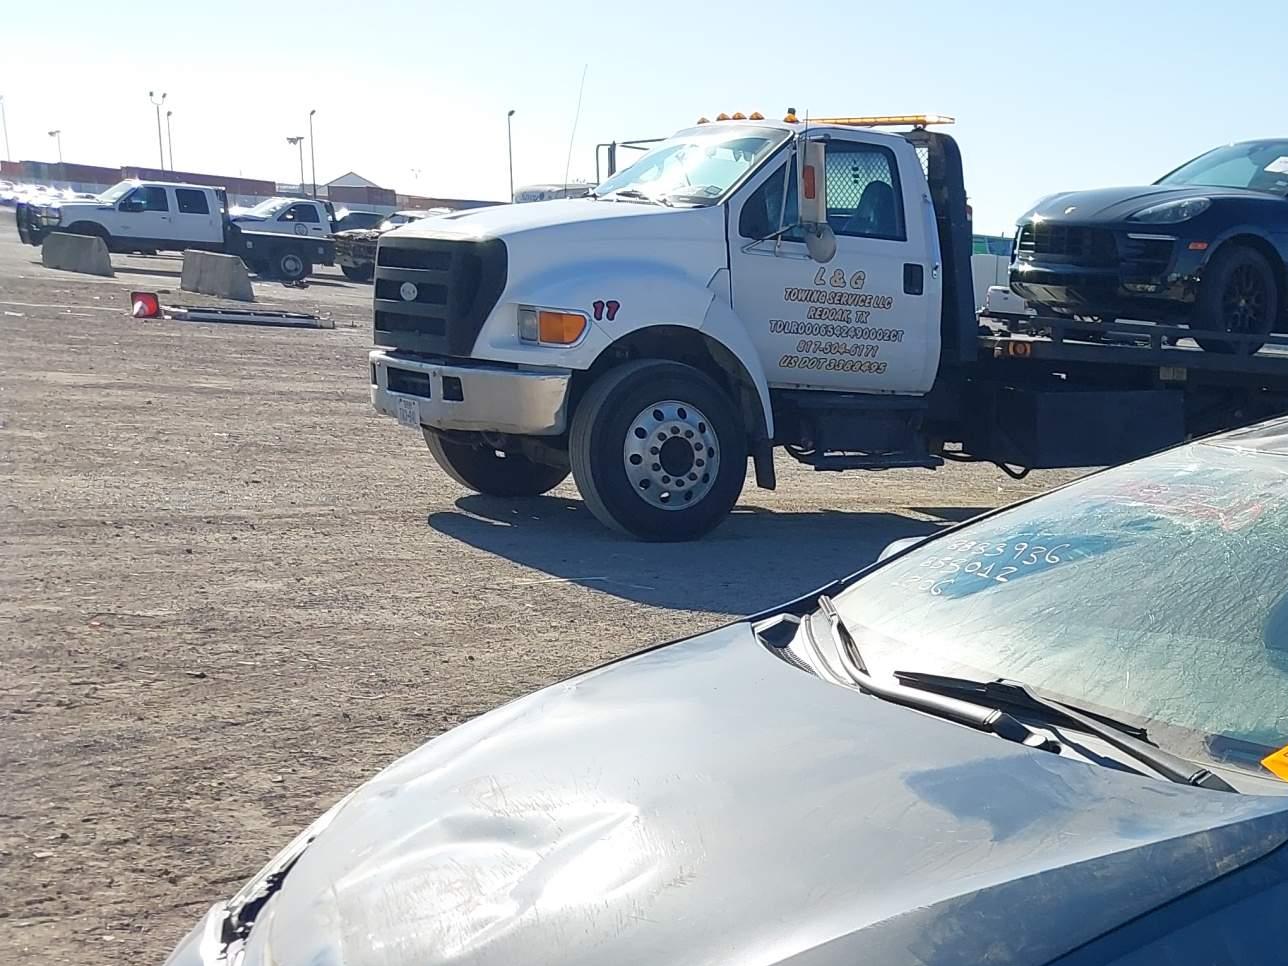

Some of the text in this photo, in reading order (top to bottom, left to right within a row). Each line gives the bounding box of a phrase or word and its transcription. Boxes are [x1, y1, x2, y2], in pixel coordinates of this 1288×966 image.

[814, 267, 866, 290] L & G
[785, 288, 893, 309] TOWING SERVICE LLC
[592, 300, 621, 321] 17
[854, 310, 871, 325] TX
[780, 355, 798, 368] US
[798, 357, 827, 371] DOT
